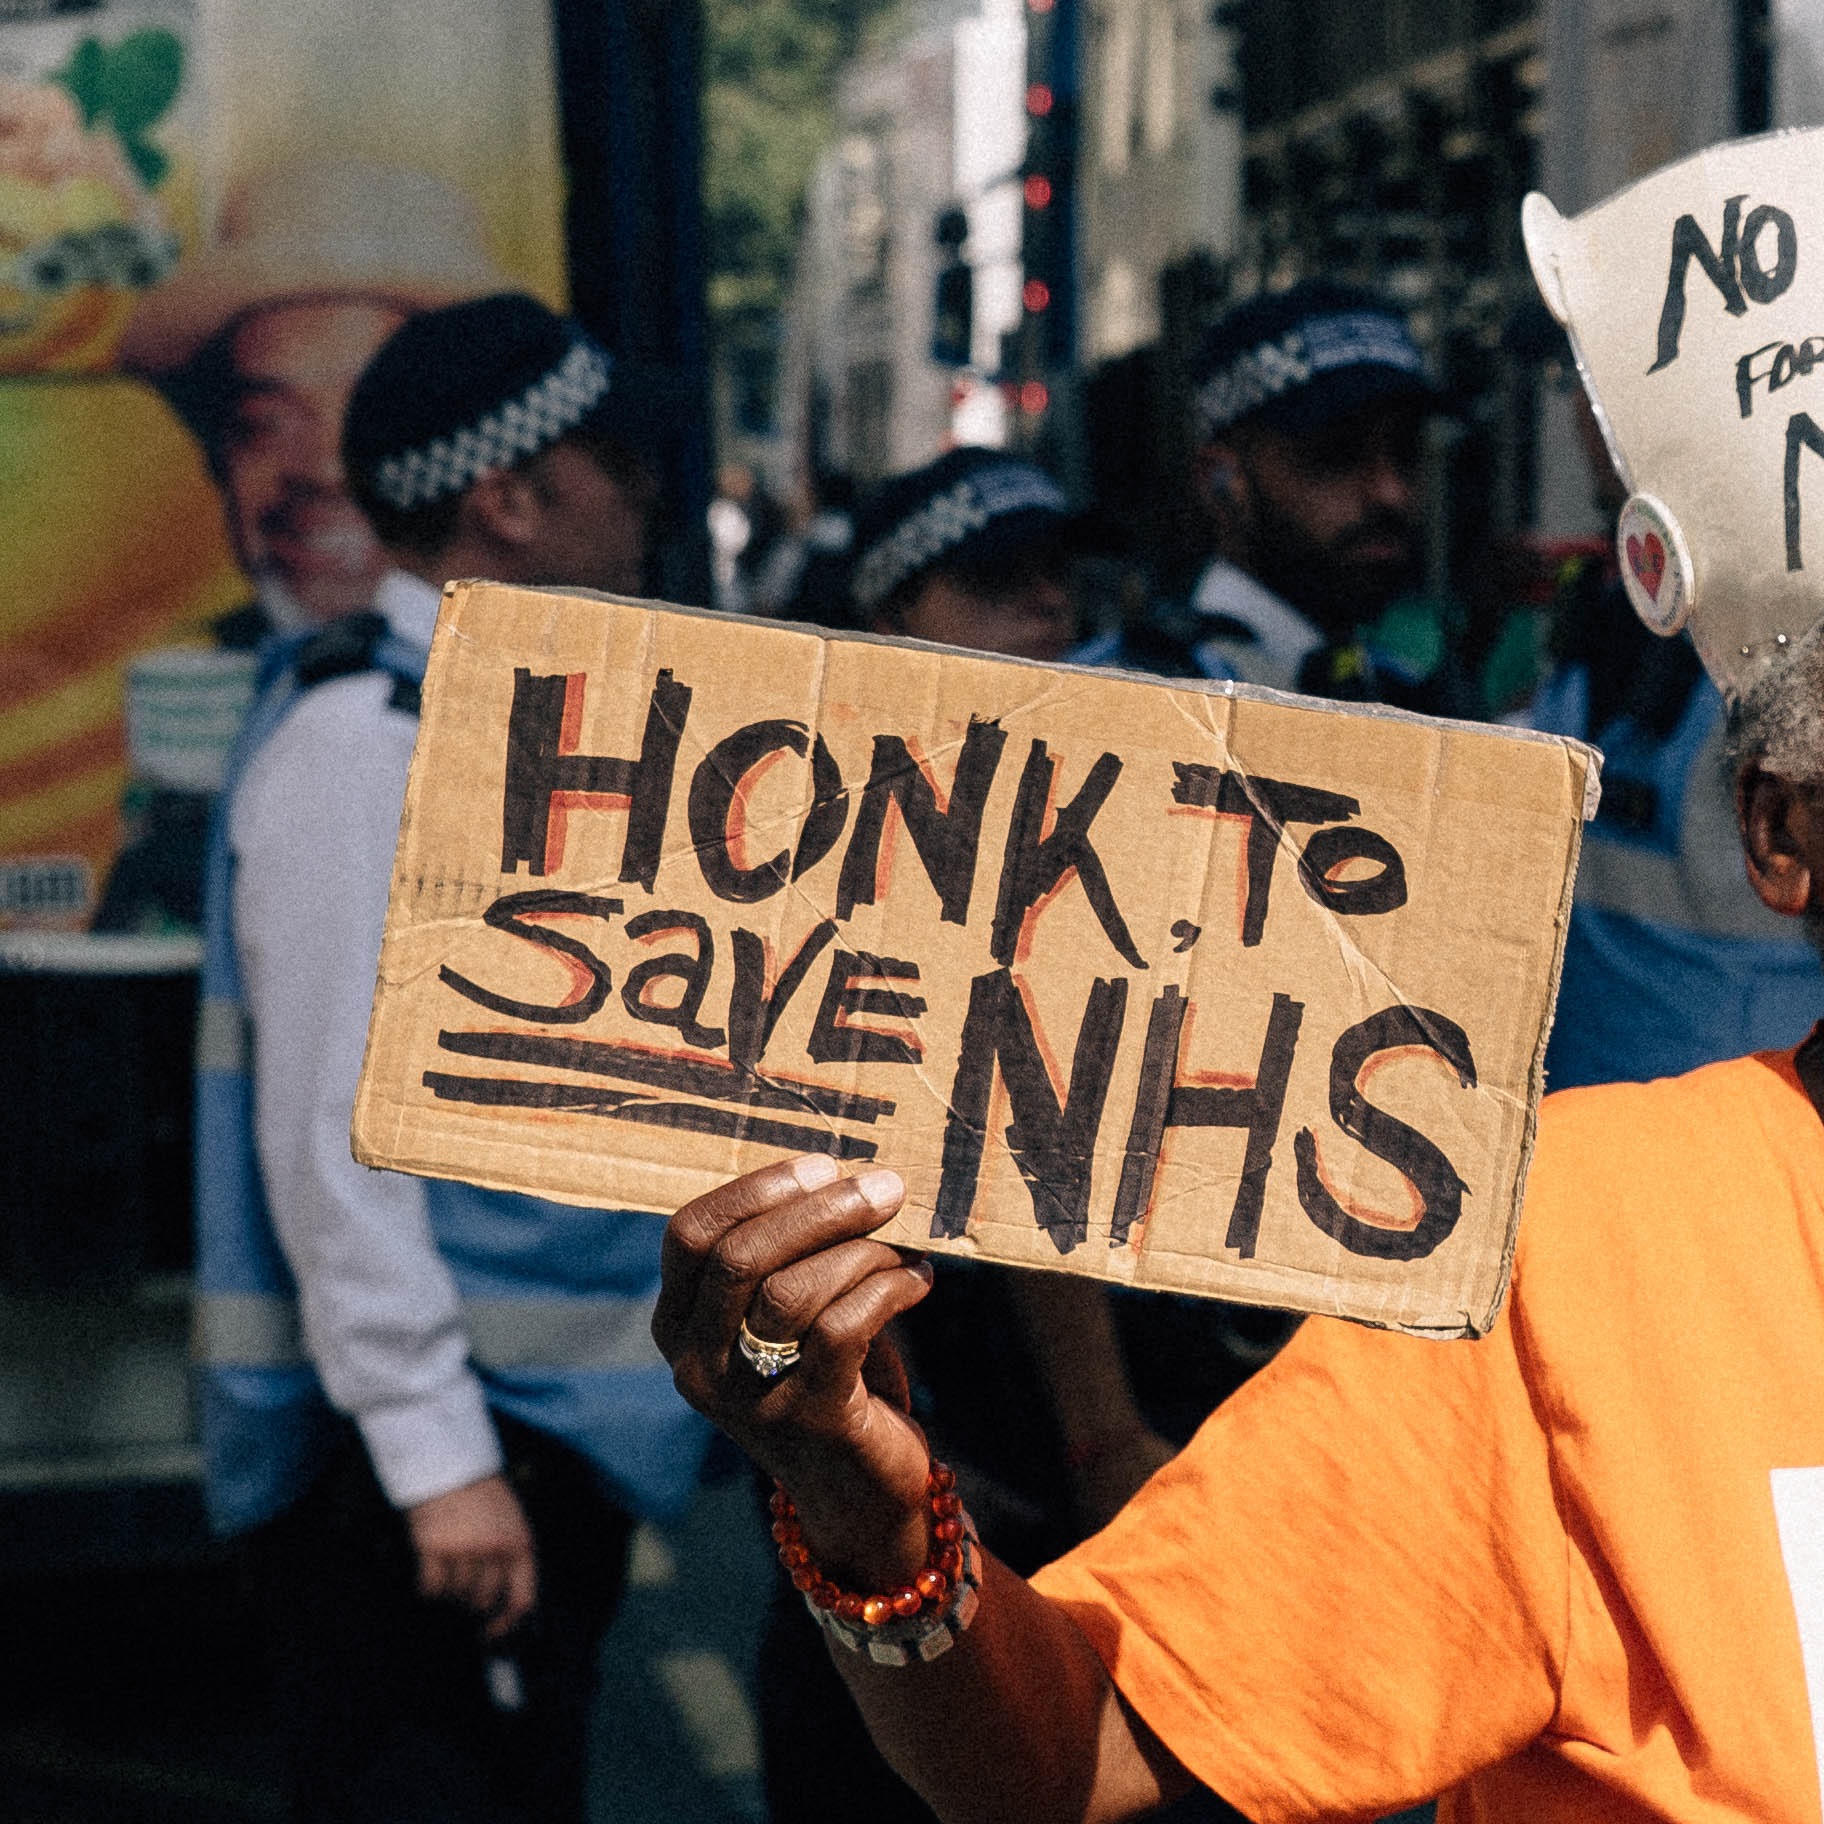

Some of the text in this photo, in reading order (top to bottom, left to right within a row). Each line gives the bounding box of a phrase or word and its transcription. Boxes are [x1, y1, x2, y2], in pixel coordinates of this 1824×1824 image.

[1646, 194, 1798, 376] NO
[1166, 760, 1410, 950] To
[930, 966, 1476, 1262] NHS
